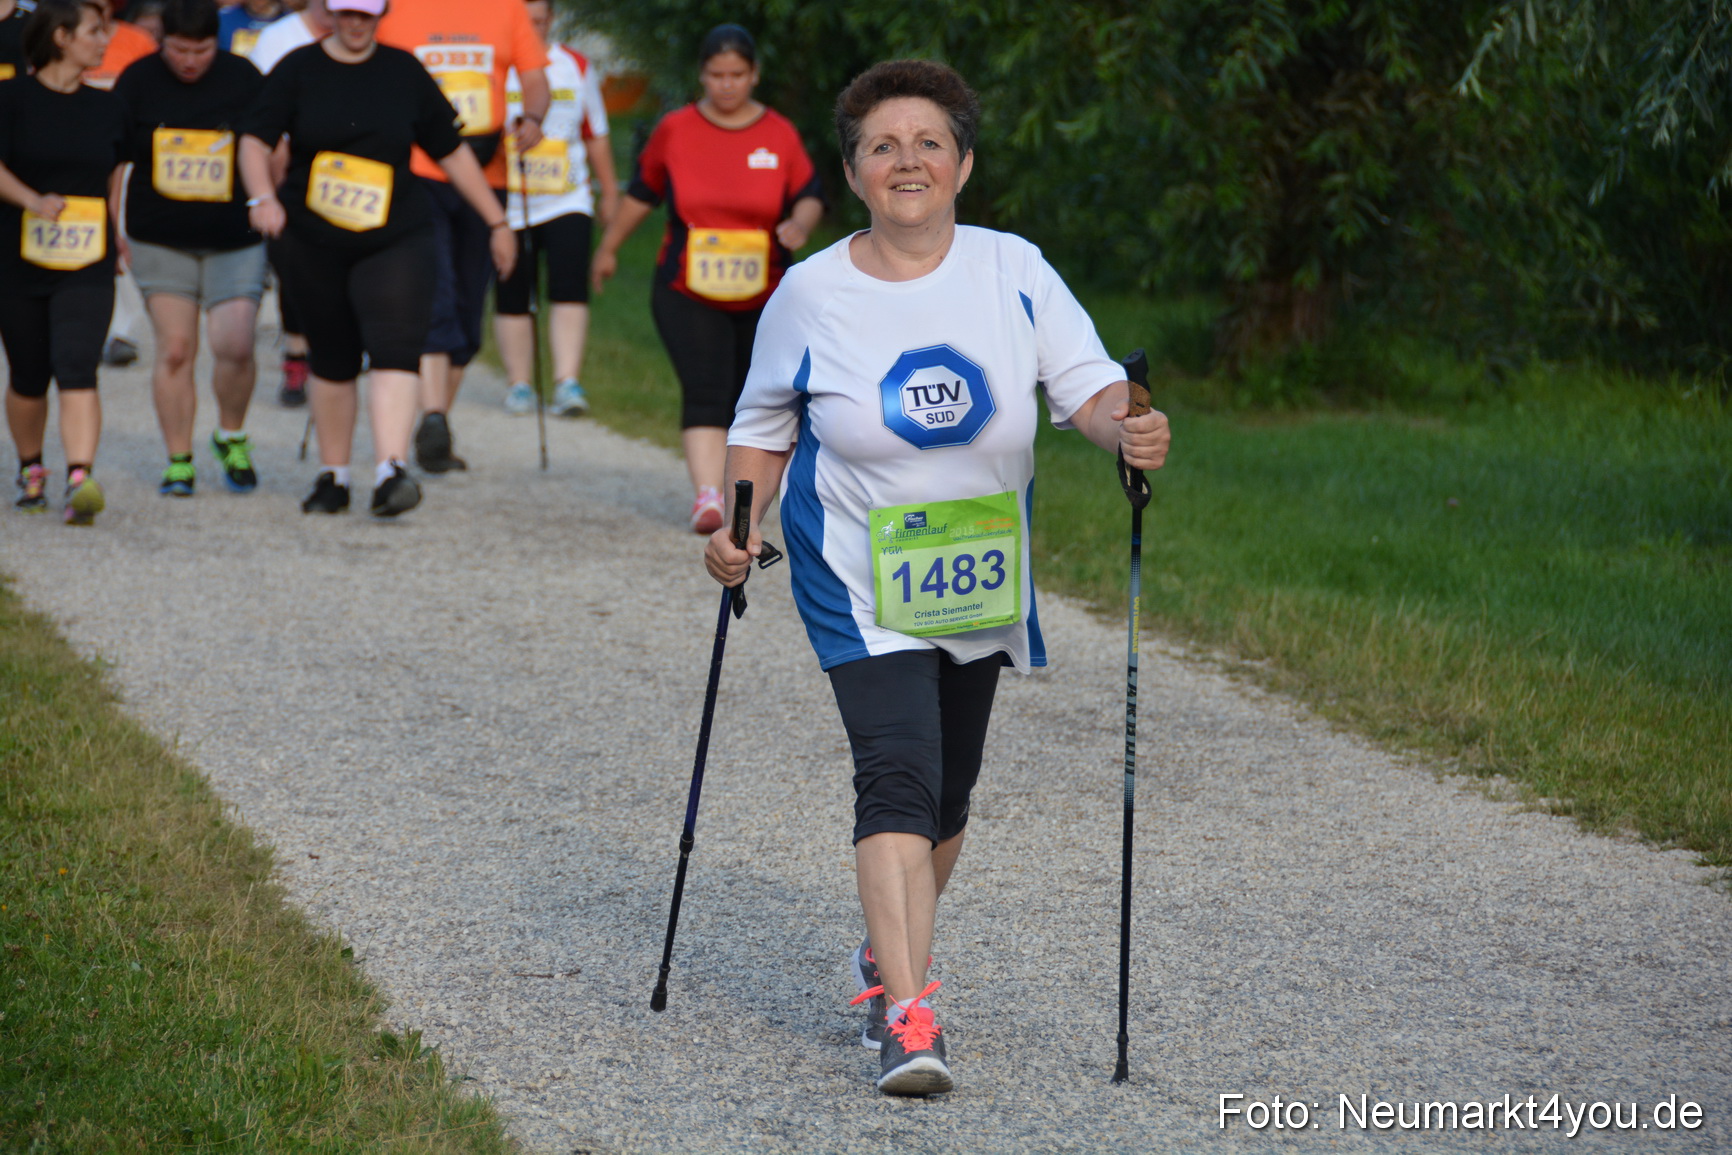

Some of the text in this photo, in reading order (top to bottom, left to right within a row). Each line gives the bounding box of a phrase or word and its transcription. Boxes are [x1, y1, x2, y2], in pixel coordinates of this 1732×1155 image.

[424, 51, 484, 66] OBI
[162, 157, 224, 182] 1270
[318, 180, 380, 215] 1272
[30, 224, 96, 250] 1257
[699, 258, 760, 282] 1170
[906, 380, 960, 407] TÜV
[926, 410, 955, 425] SÜD
[895, 523, 975, 538] firmenlauf 2015
[892, 549, 1006, 603] 1483
[914, 602, 983, 619] Crista Siemantel
[949, 615, 968, 623] SERVICE
